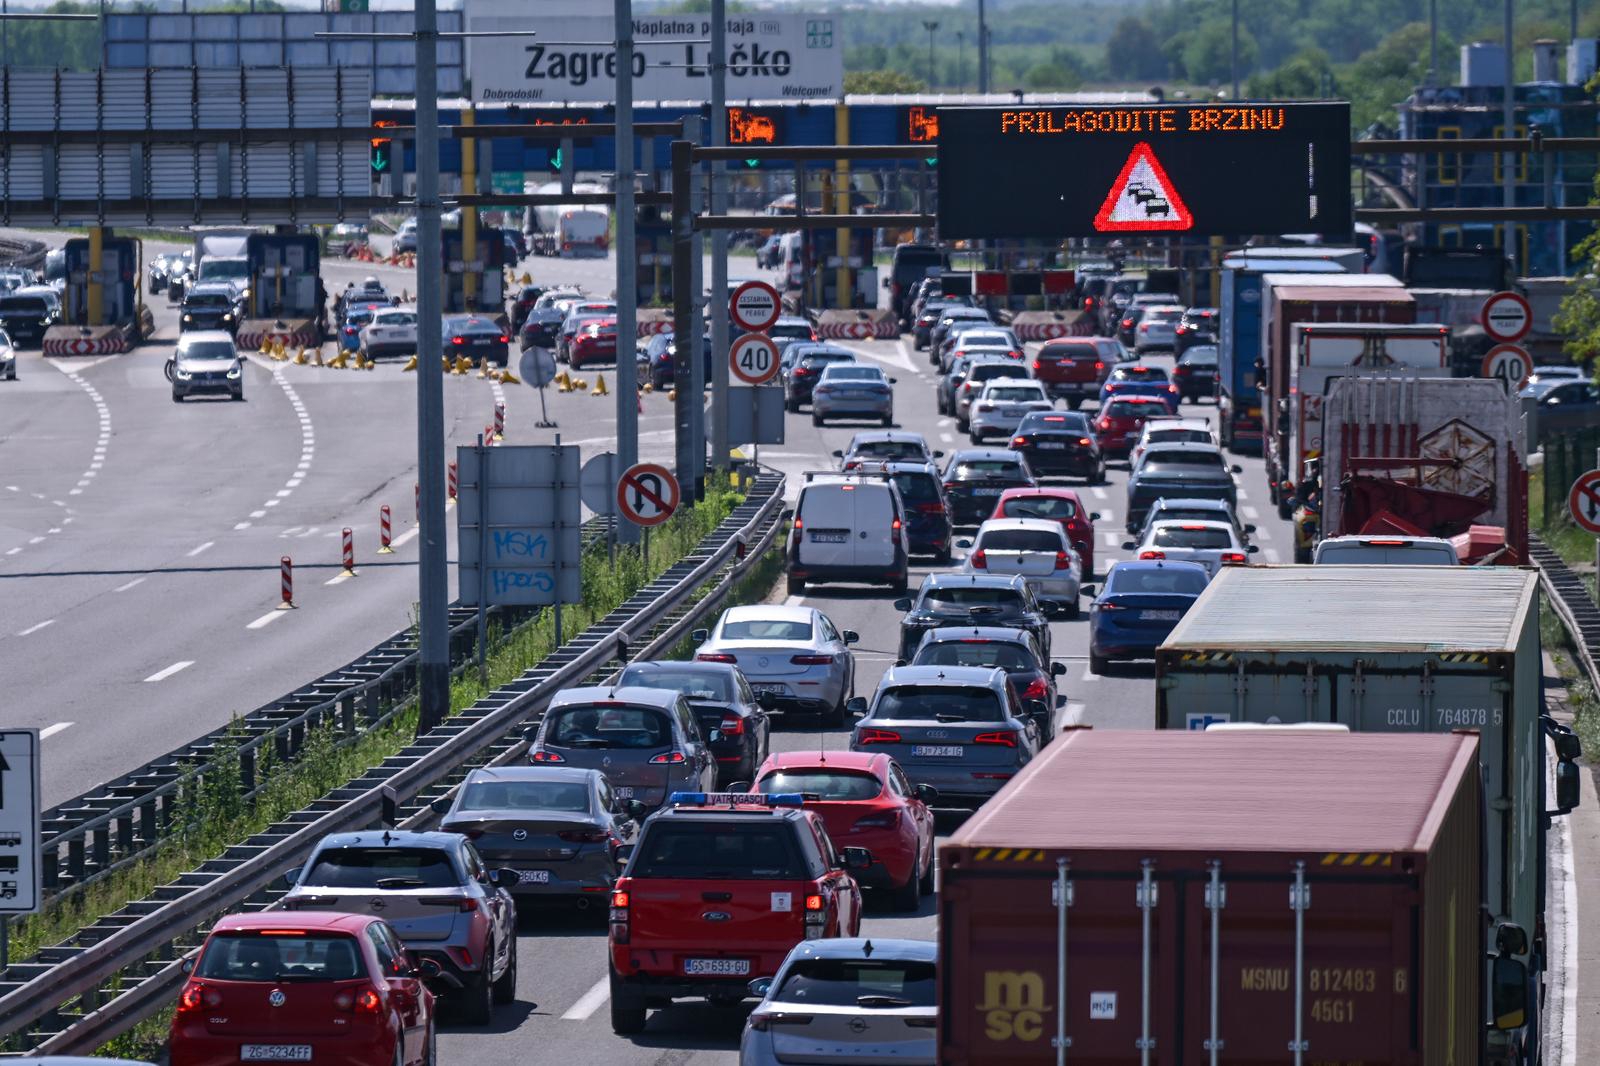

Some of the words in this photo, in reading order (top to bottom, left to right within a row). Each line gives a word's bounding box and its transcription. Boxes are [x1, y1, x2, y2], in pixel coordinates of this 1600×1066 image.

[632, 20, 694, 37] Naplatna
[701, 20, 754, 37] ptaja
[685, 43, 790, 77] Lčko
[782, 85, 832, 96] Welcome!
[1001, 110, 1176, 133] PRILAGODITE
[1188, 108, 1285, 131] BRZINU
[741, 347, 769, 371] 40
[1495, 358, 1522, 381] 40
[1387, 708, 1420, 725] CCLU
[1437, 708, 1487, 725] 764878
[1493, 708, 1502, 725] 5
[1241, 968, 1289, 991] MSNU
[1309, 968, 1376, 992] 812483
[1395, 968, 1407, 992] 6
[1311, 1000, 1353, 1022] 45G1
